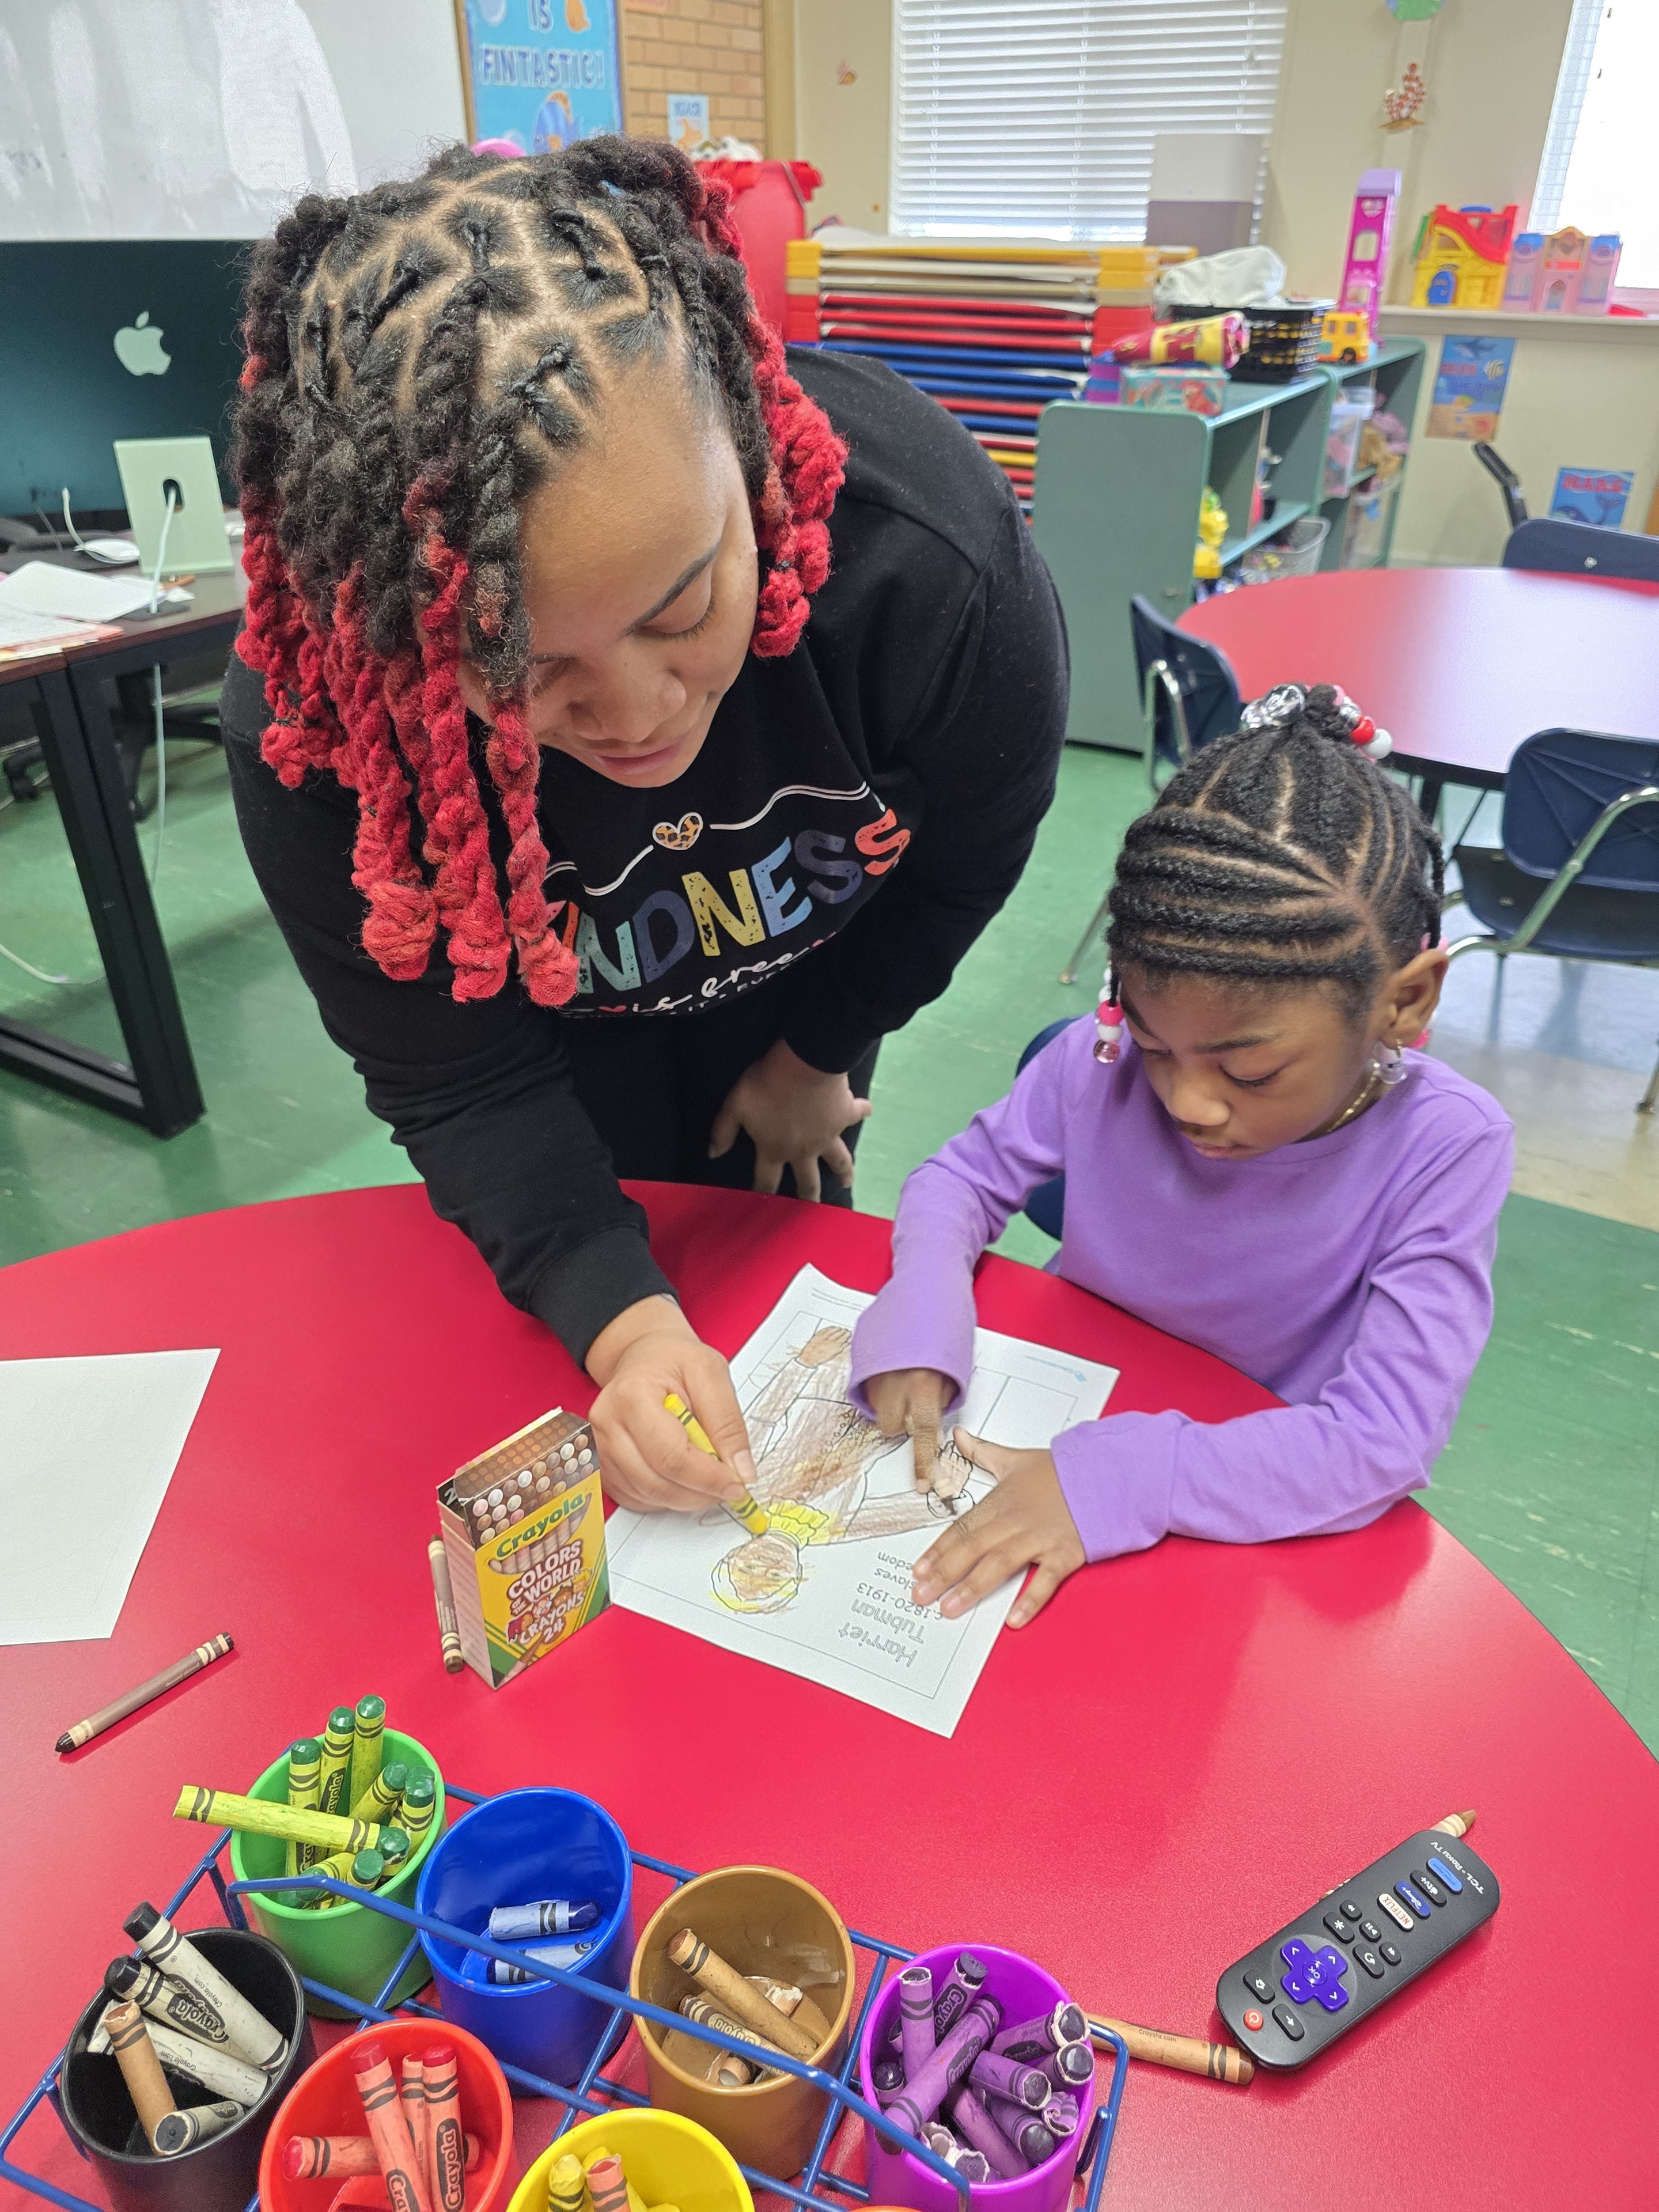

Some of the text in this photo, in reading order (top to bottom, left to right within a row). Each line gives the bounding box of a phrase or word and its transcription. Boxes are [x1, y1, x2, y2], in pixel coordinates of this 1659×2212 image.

[529, 0, 553, 33] IS
[481, 43, 604, 89] FINTASTIC!
[546, 807, 912, 994] INDNESS
[497, 1494, 584, 1558] Crayola
[508, 1541, 581, 1600] COLORS
[524, 1559, 581, 1603] WORLD
[877, 1551, 915, 1571] edom
[520, 1590, 584, 1645] CRAYONS
[544, 1618, 565, 1643] 24
[851, 1599, 925, 1643] Tubman
[838, 1622, 918, 1668] Harriet
[327, 1774, 344, 1815] ayola
[1430, 1842, 1443, 1853] TV
[1467, 1873, 1484, 1894] TCL
[1383, 1896, 1411, 1925] NETFLIX
[194, 1976, 223, 2008] Crayola.com
[1308, 1965, 1321, 1979] OK
[934, 1988, 964, 2036] Crayo
[1138, 2029, 1176, 2043] Crayola.com
[161, 2050, 197, 2071] Crayola.com
[441, 2128, 461, 2209] Crayola
